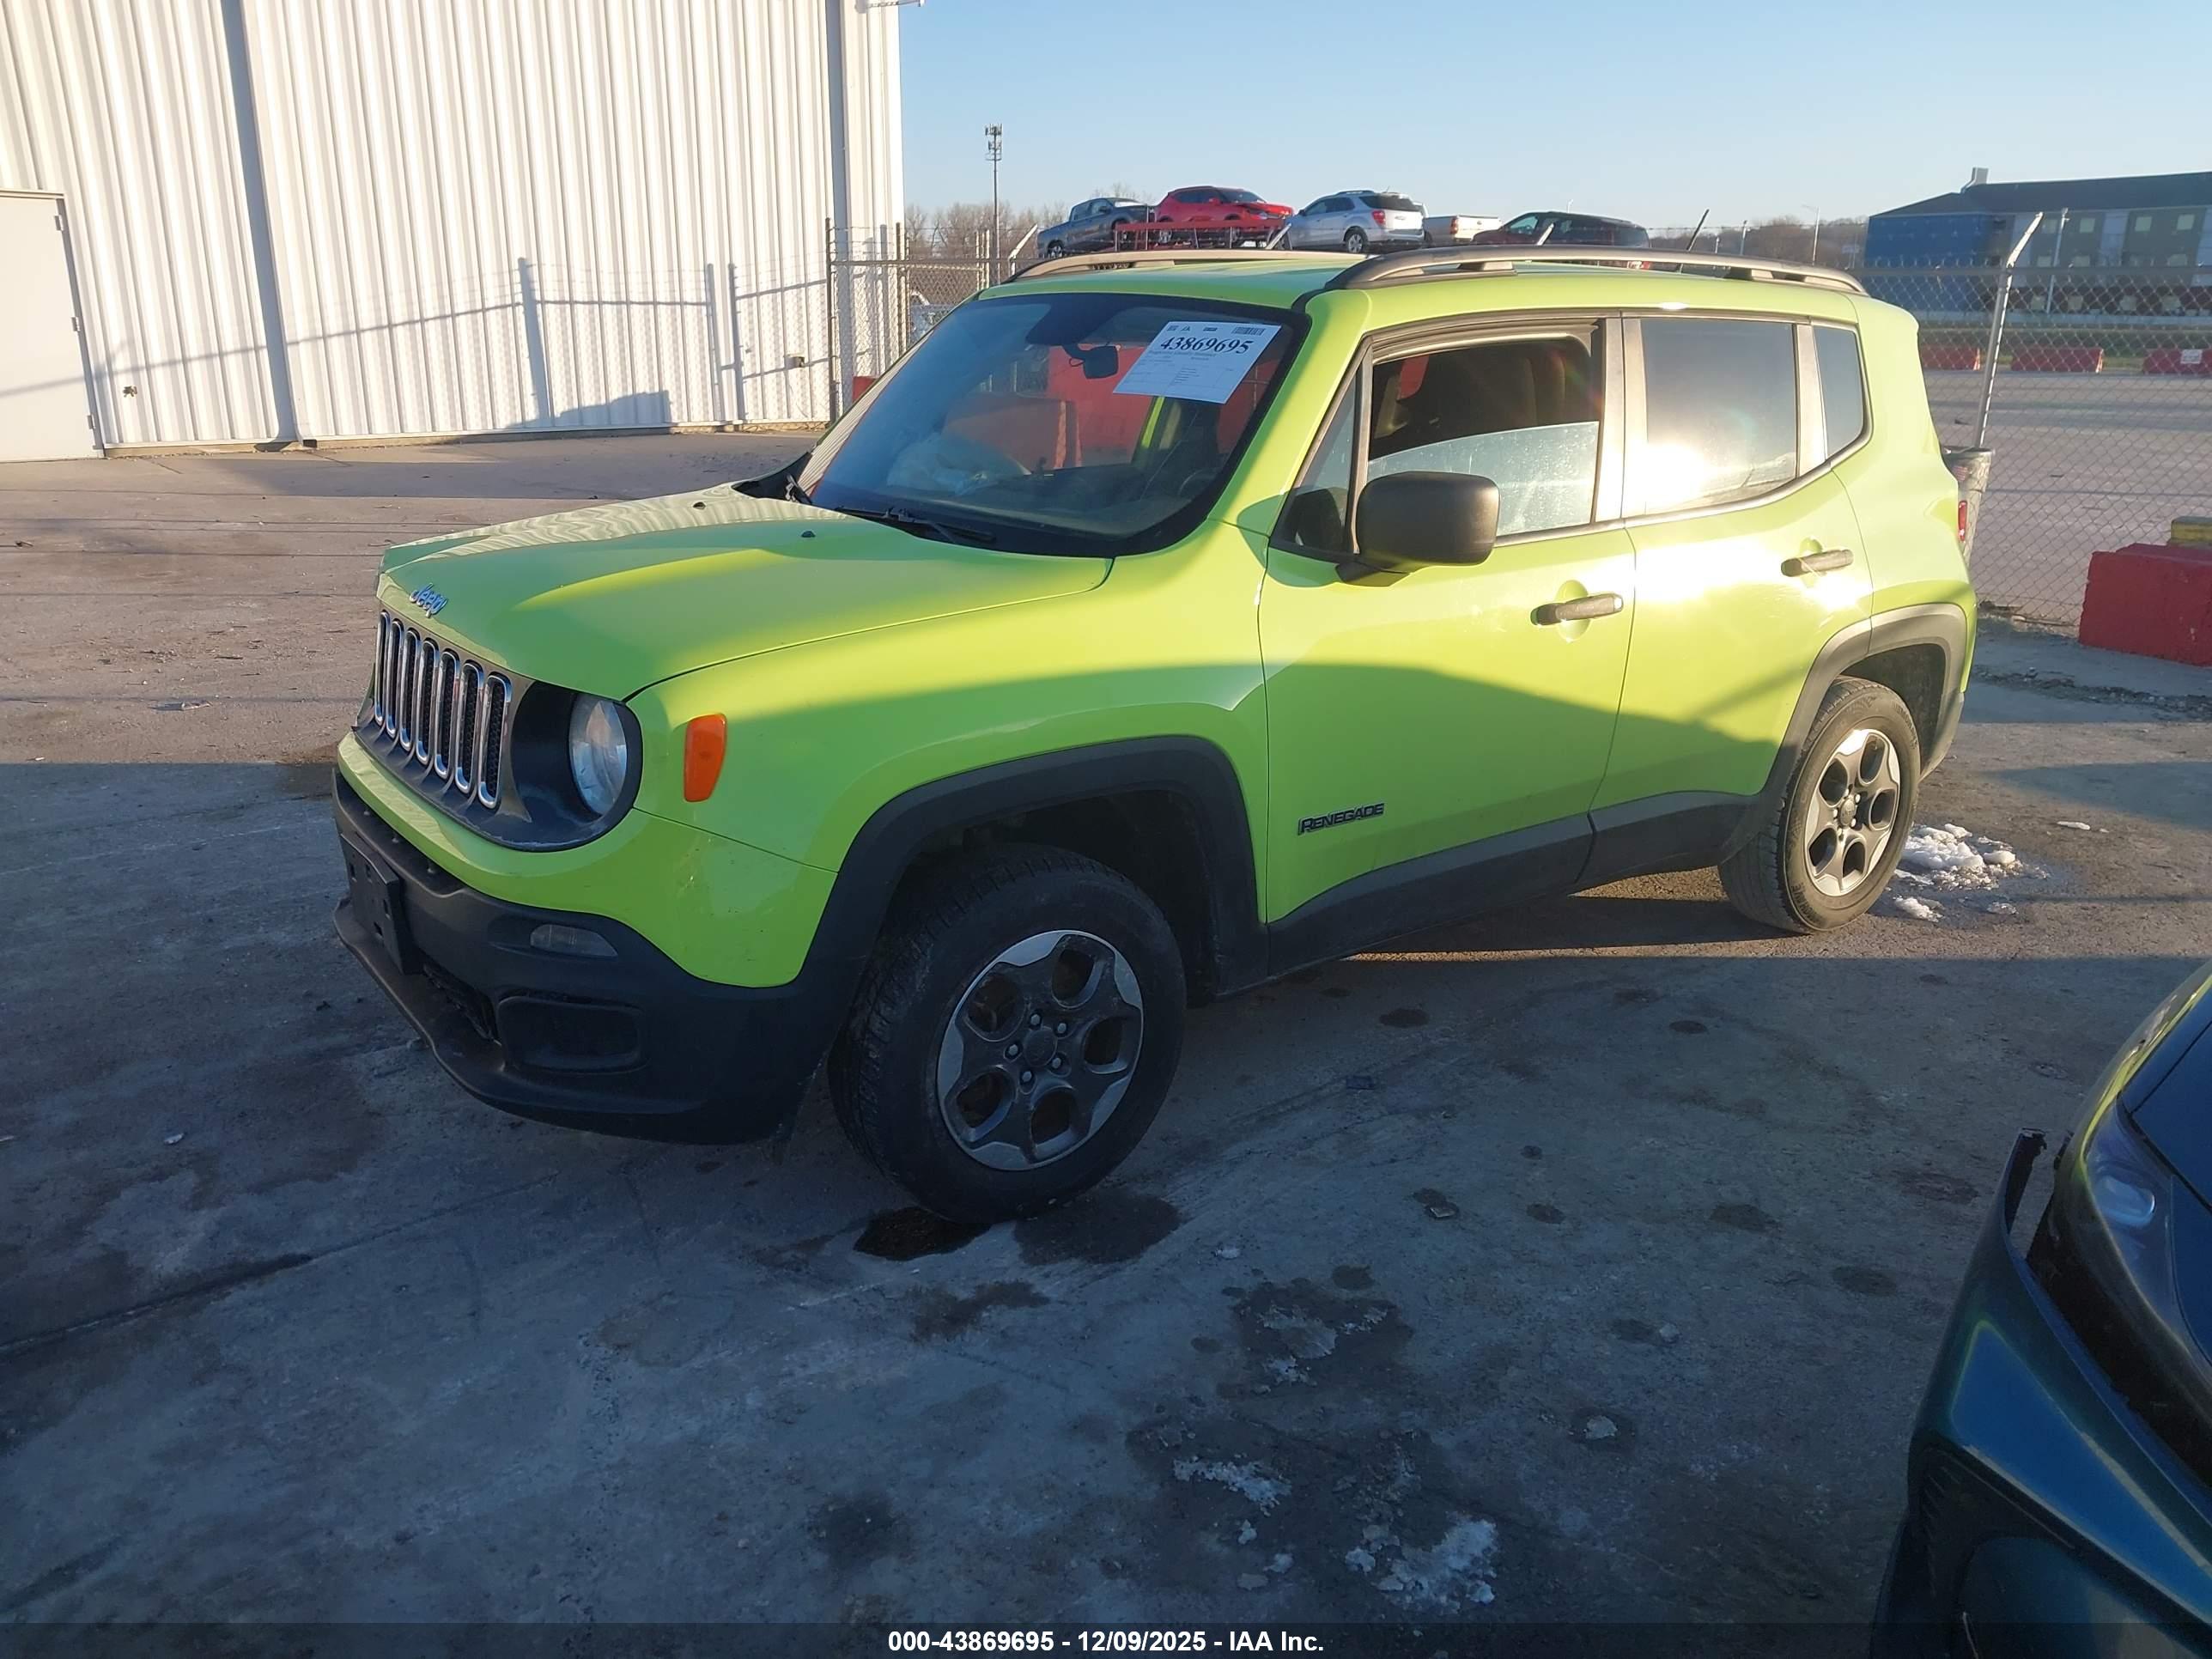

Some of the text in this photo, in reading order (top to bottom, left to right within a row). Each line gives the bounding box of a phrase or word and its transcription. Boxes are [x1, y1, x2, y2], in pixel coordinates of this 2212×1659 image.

[1160, 336, 1254, 354] 43869695
[409, 582, 448, 618] Jeep
[1297, 803, 1385, 836] RENEGADE
